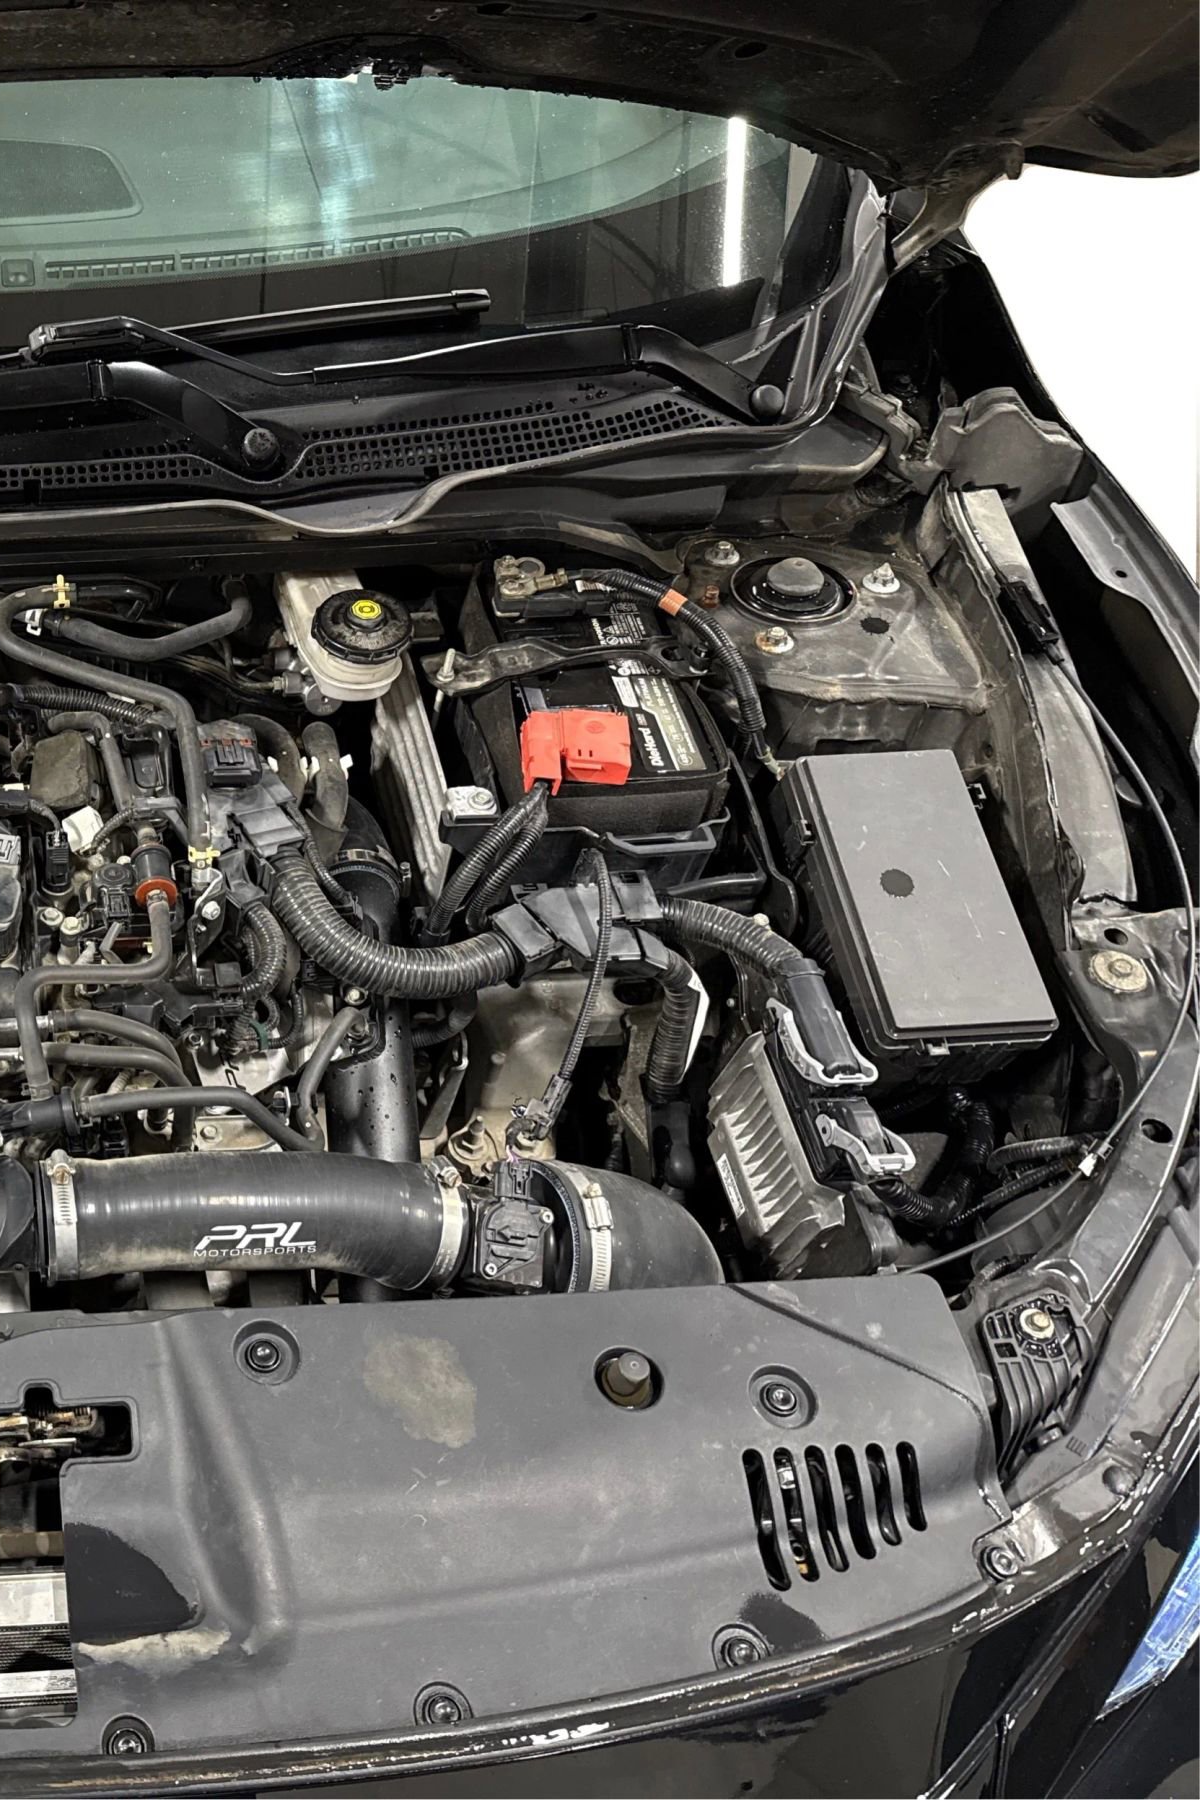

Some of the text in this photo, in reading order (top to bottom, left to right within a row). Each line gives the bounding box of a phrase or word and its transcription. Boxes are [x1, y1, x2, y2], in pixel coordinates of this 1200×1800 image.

[638, 726, 665, 767] DieHard
[194, 1221, 317, 1250] PRL
[193, 1245, 318, 1257] MOTORSPORTS
